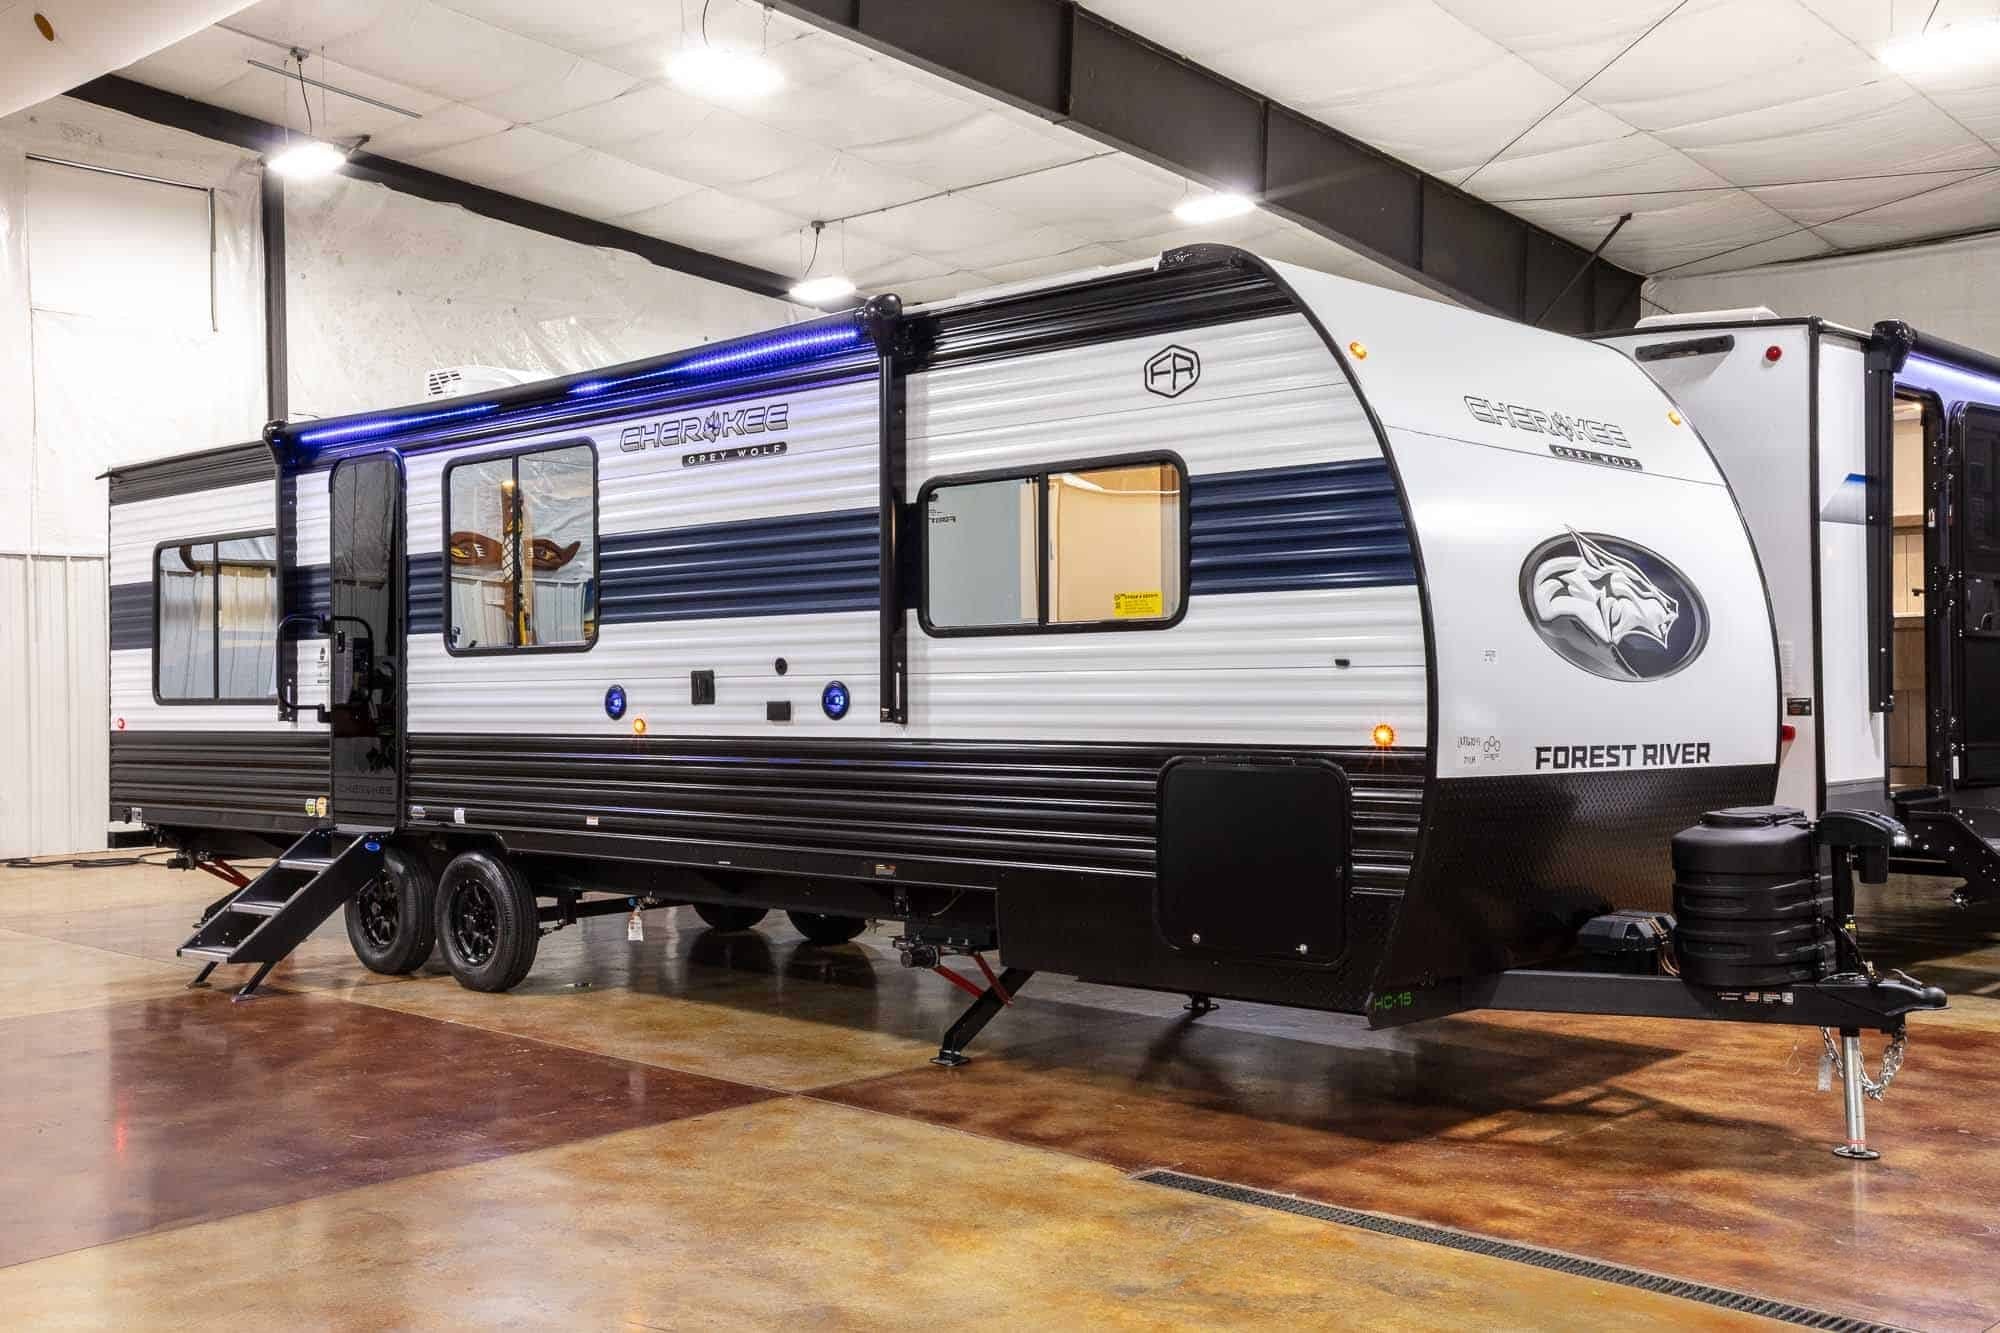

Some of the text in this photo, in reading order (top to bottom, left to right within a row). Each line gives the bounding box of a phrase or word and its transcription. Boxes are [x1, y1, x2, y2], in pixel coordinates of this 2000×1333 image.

[687, 444, 781, 465] GREY WOLF
[1555, 446, 1638, 468] GREY WOLF
[1535, 742, 1711, 770] FOREST RIVER
